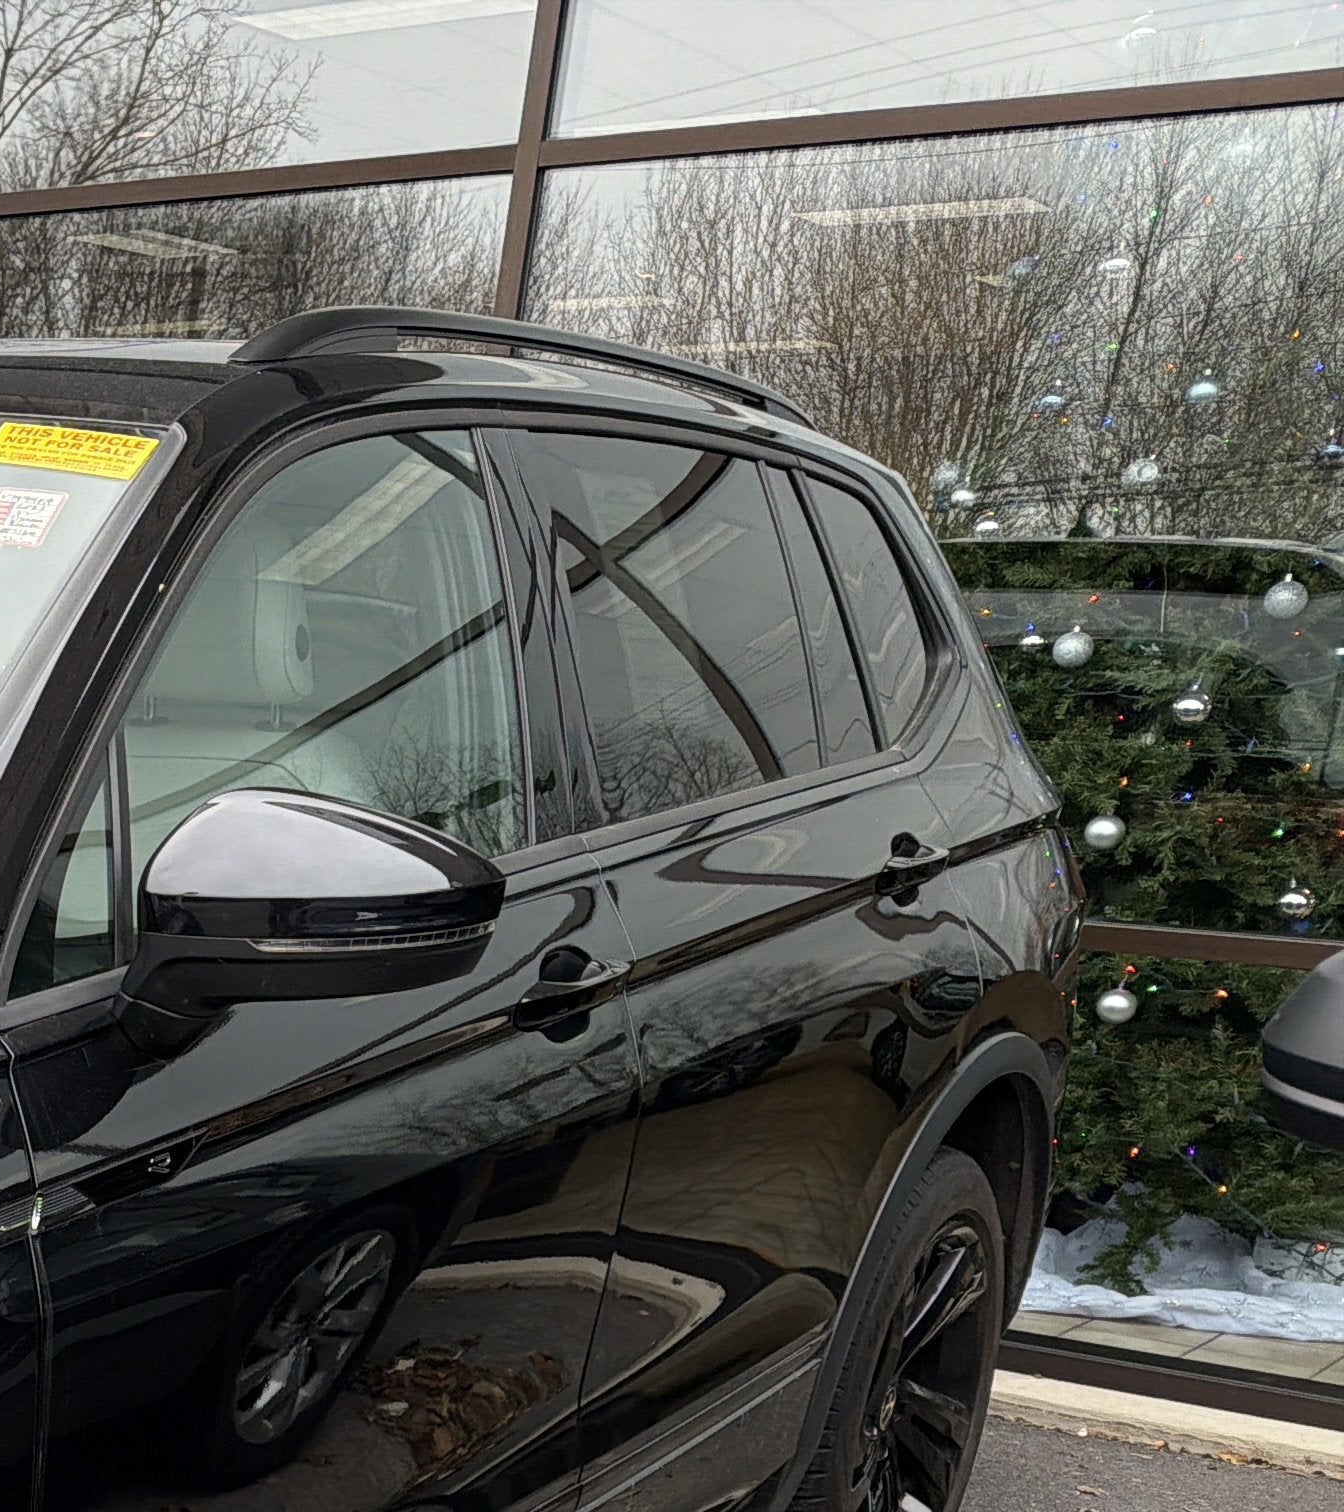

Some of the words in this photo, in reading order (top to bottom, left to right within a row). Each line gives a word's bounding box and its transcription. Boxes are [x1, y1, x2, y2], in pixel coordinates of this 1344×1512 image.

[3, 436, 42, 446] NOT
[44, 439, 83, 450] FOR
[87, 444, 138, 457] SALE
[8, 426, 54, 438] THIS
[60, 430, 150, 450] VEHICLE
